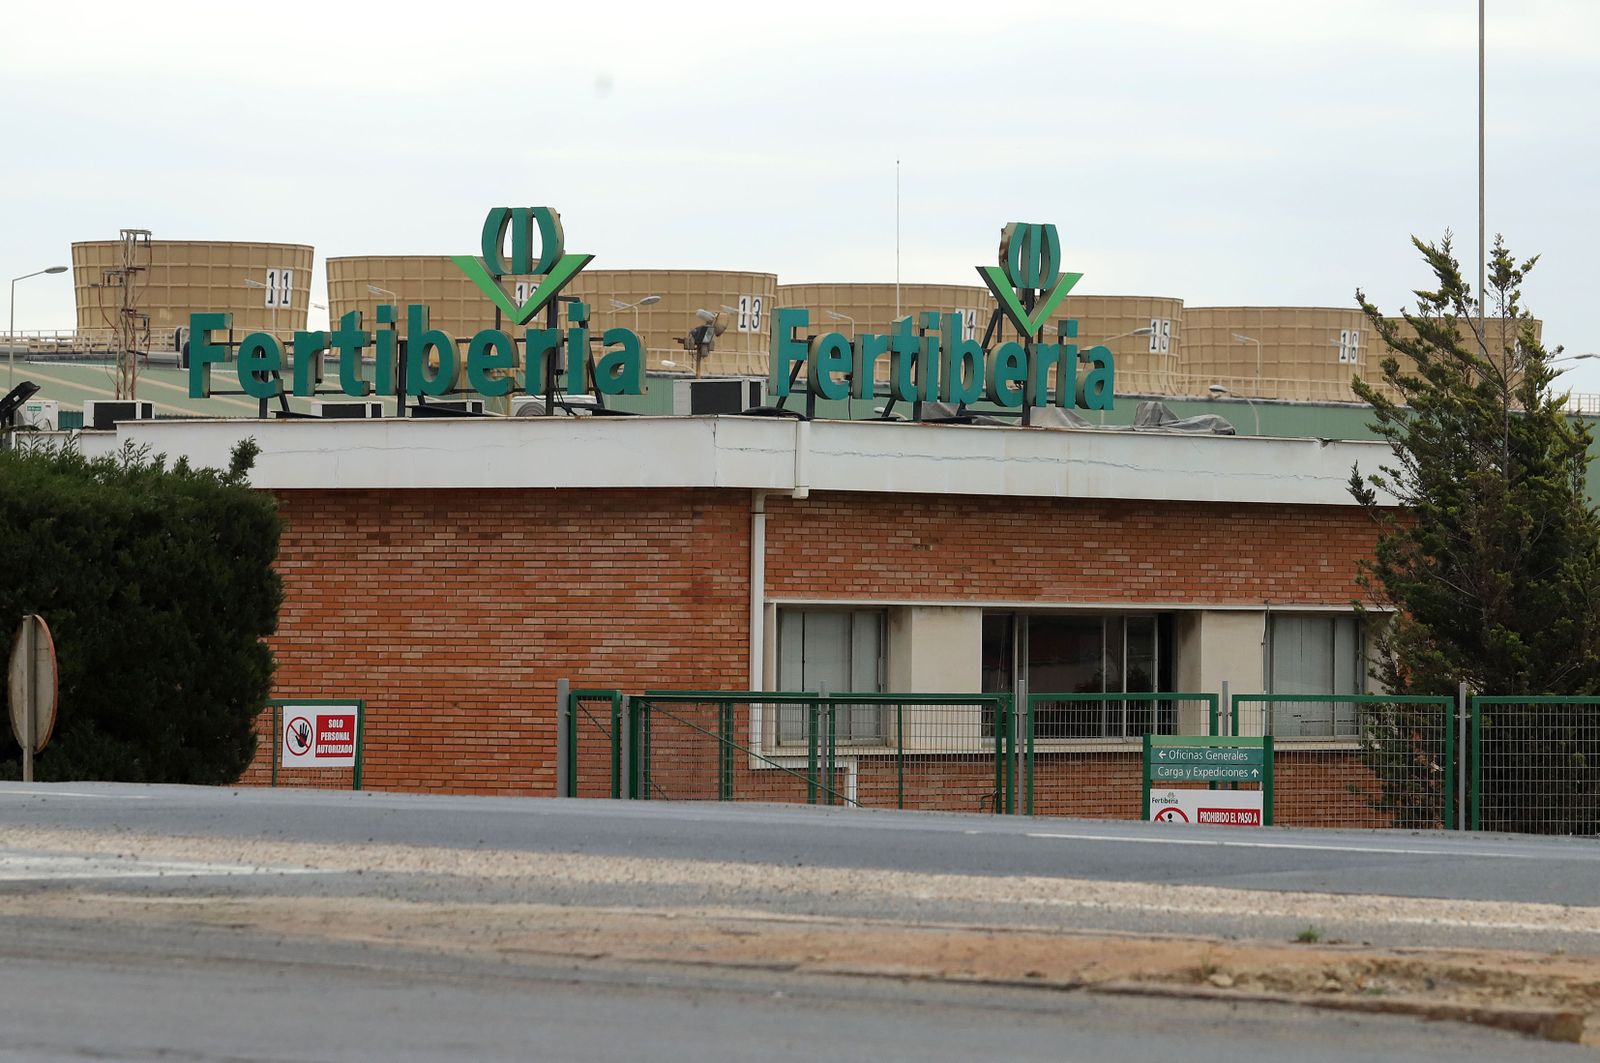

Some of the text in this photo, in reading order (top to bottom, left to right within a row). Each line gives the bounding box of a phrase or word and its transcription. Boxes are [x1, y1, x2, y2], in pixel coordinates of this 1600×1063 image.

[267, 271, 289, 304] 11
[740, 298, 761, 329] 13
[1151, 321, 1169, 350] 15
[189, 304, 647, 398] Fertiberia
[769, 308, 1115, 410] Fertiberia
[328, 719, 344, 728] SOLO
[320, 732, 350, 741] PERSONAL
[316, 744, 353, 754] AUTORIZADO
[1168, 749, 1248, 761] Oficinas Generales
[1157, 766, 1249, 778] Carga y Expediciones
[1200, 811, 1258, 824] PROHIBIDO EL PASO A
